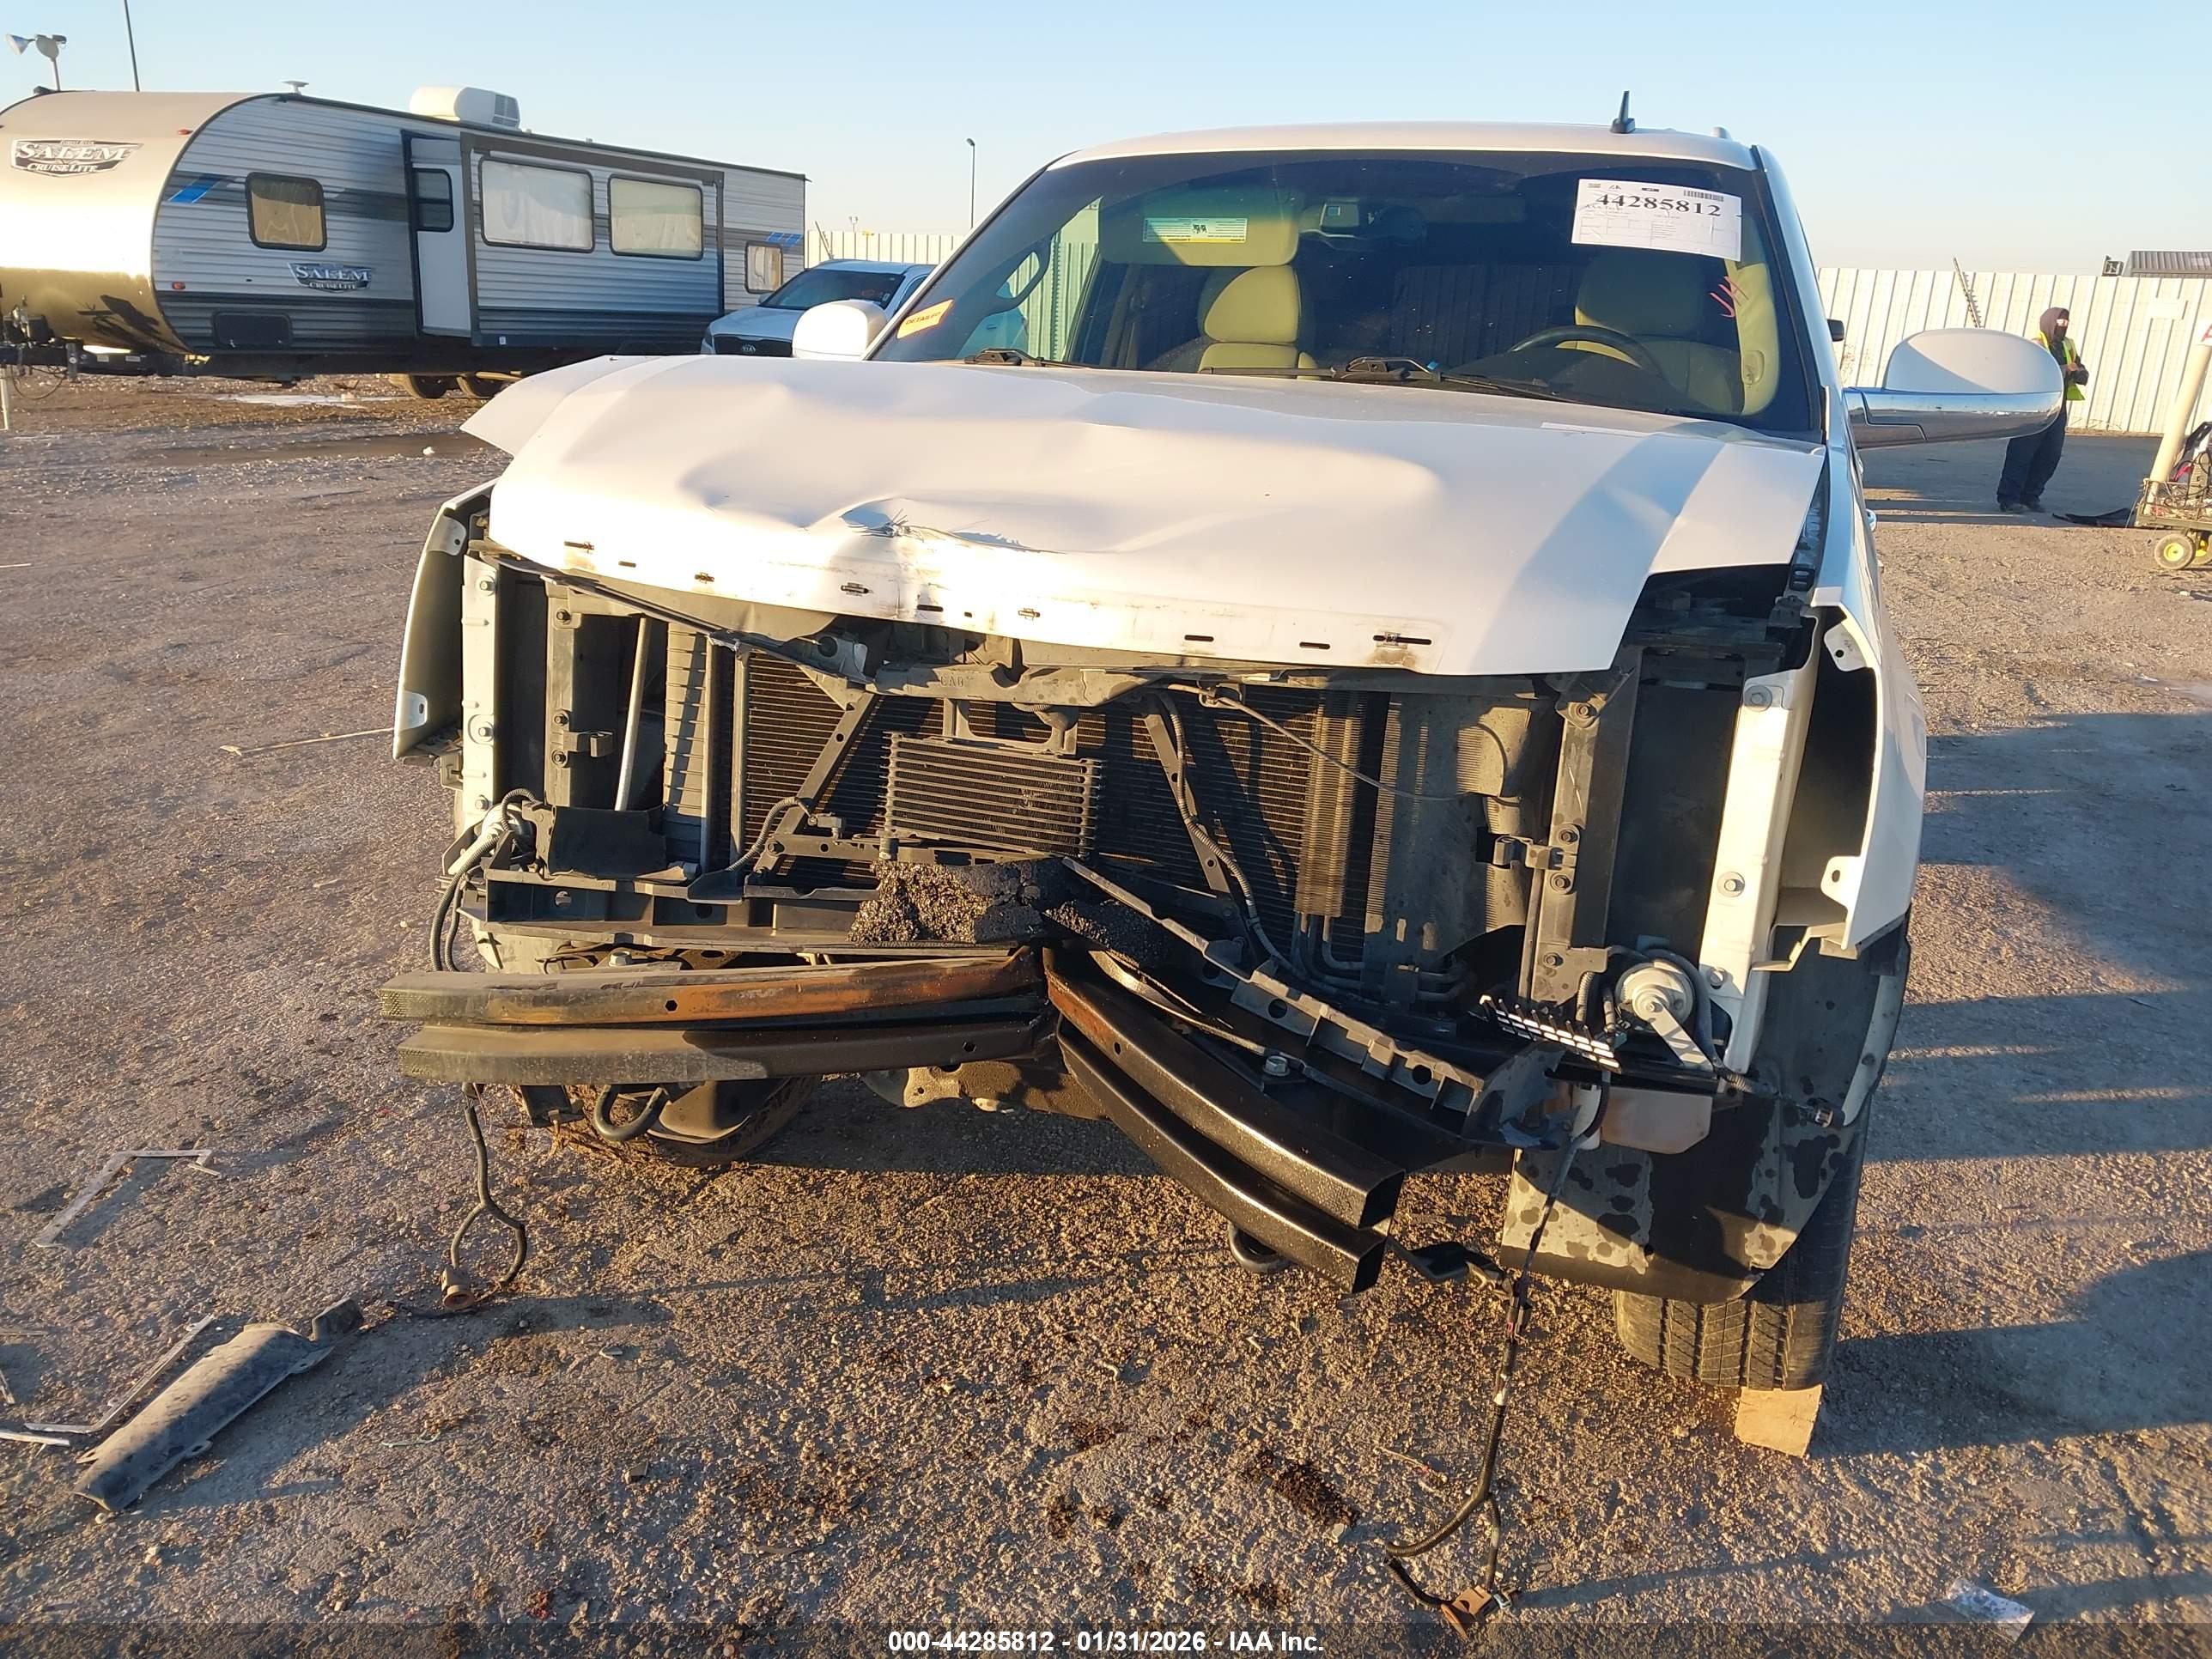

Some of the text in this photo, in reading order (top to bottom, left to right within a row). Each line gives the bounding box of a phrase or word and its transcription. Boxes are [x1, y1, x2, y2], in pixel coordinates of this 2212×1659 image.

[16, 143, 128, 161] SALEM
[1595, 193, 1722, 216] 44285812
[295, 266, 370, 281] SALEM
